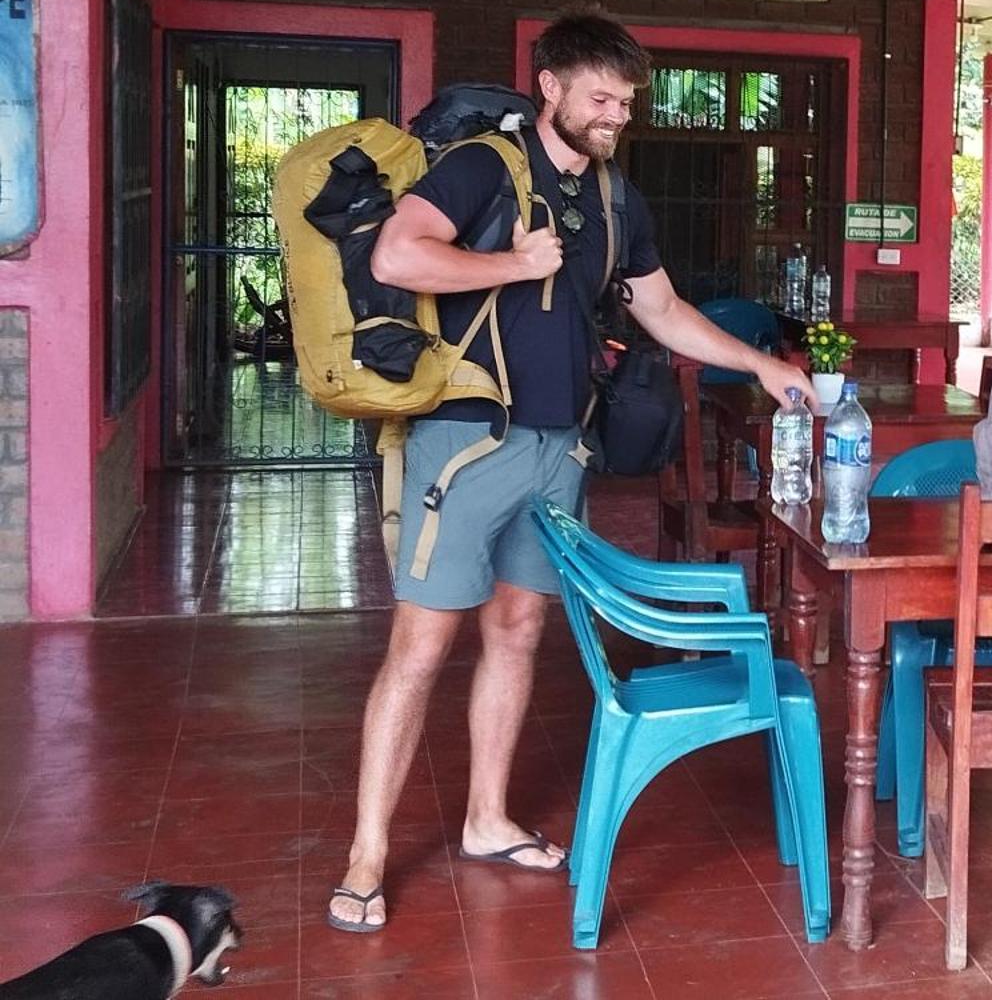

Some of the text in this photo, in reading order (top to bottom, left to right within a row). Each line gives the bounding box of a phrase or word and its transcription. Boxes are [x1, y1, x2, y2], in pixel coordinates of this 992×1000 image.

[854, 207, 897, 217] RUTA DE
[849, 228, 900, 238] EVACUAION
